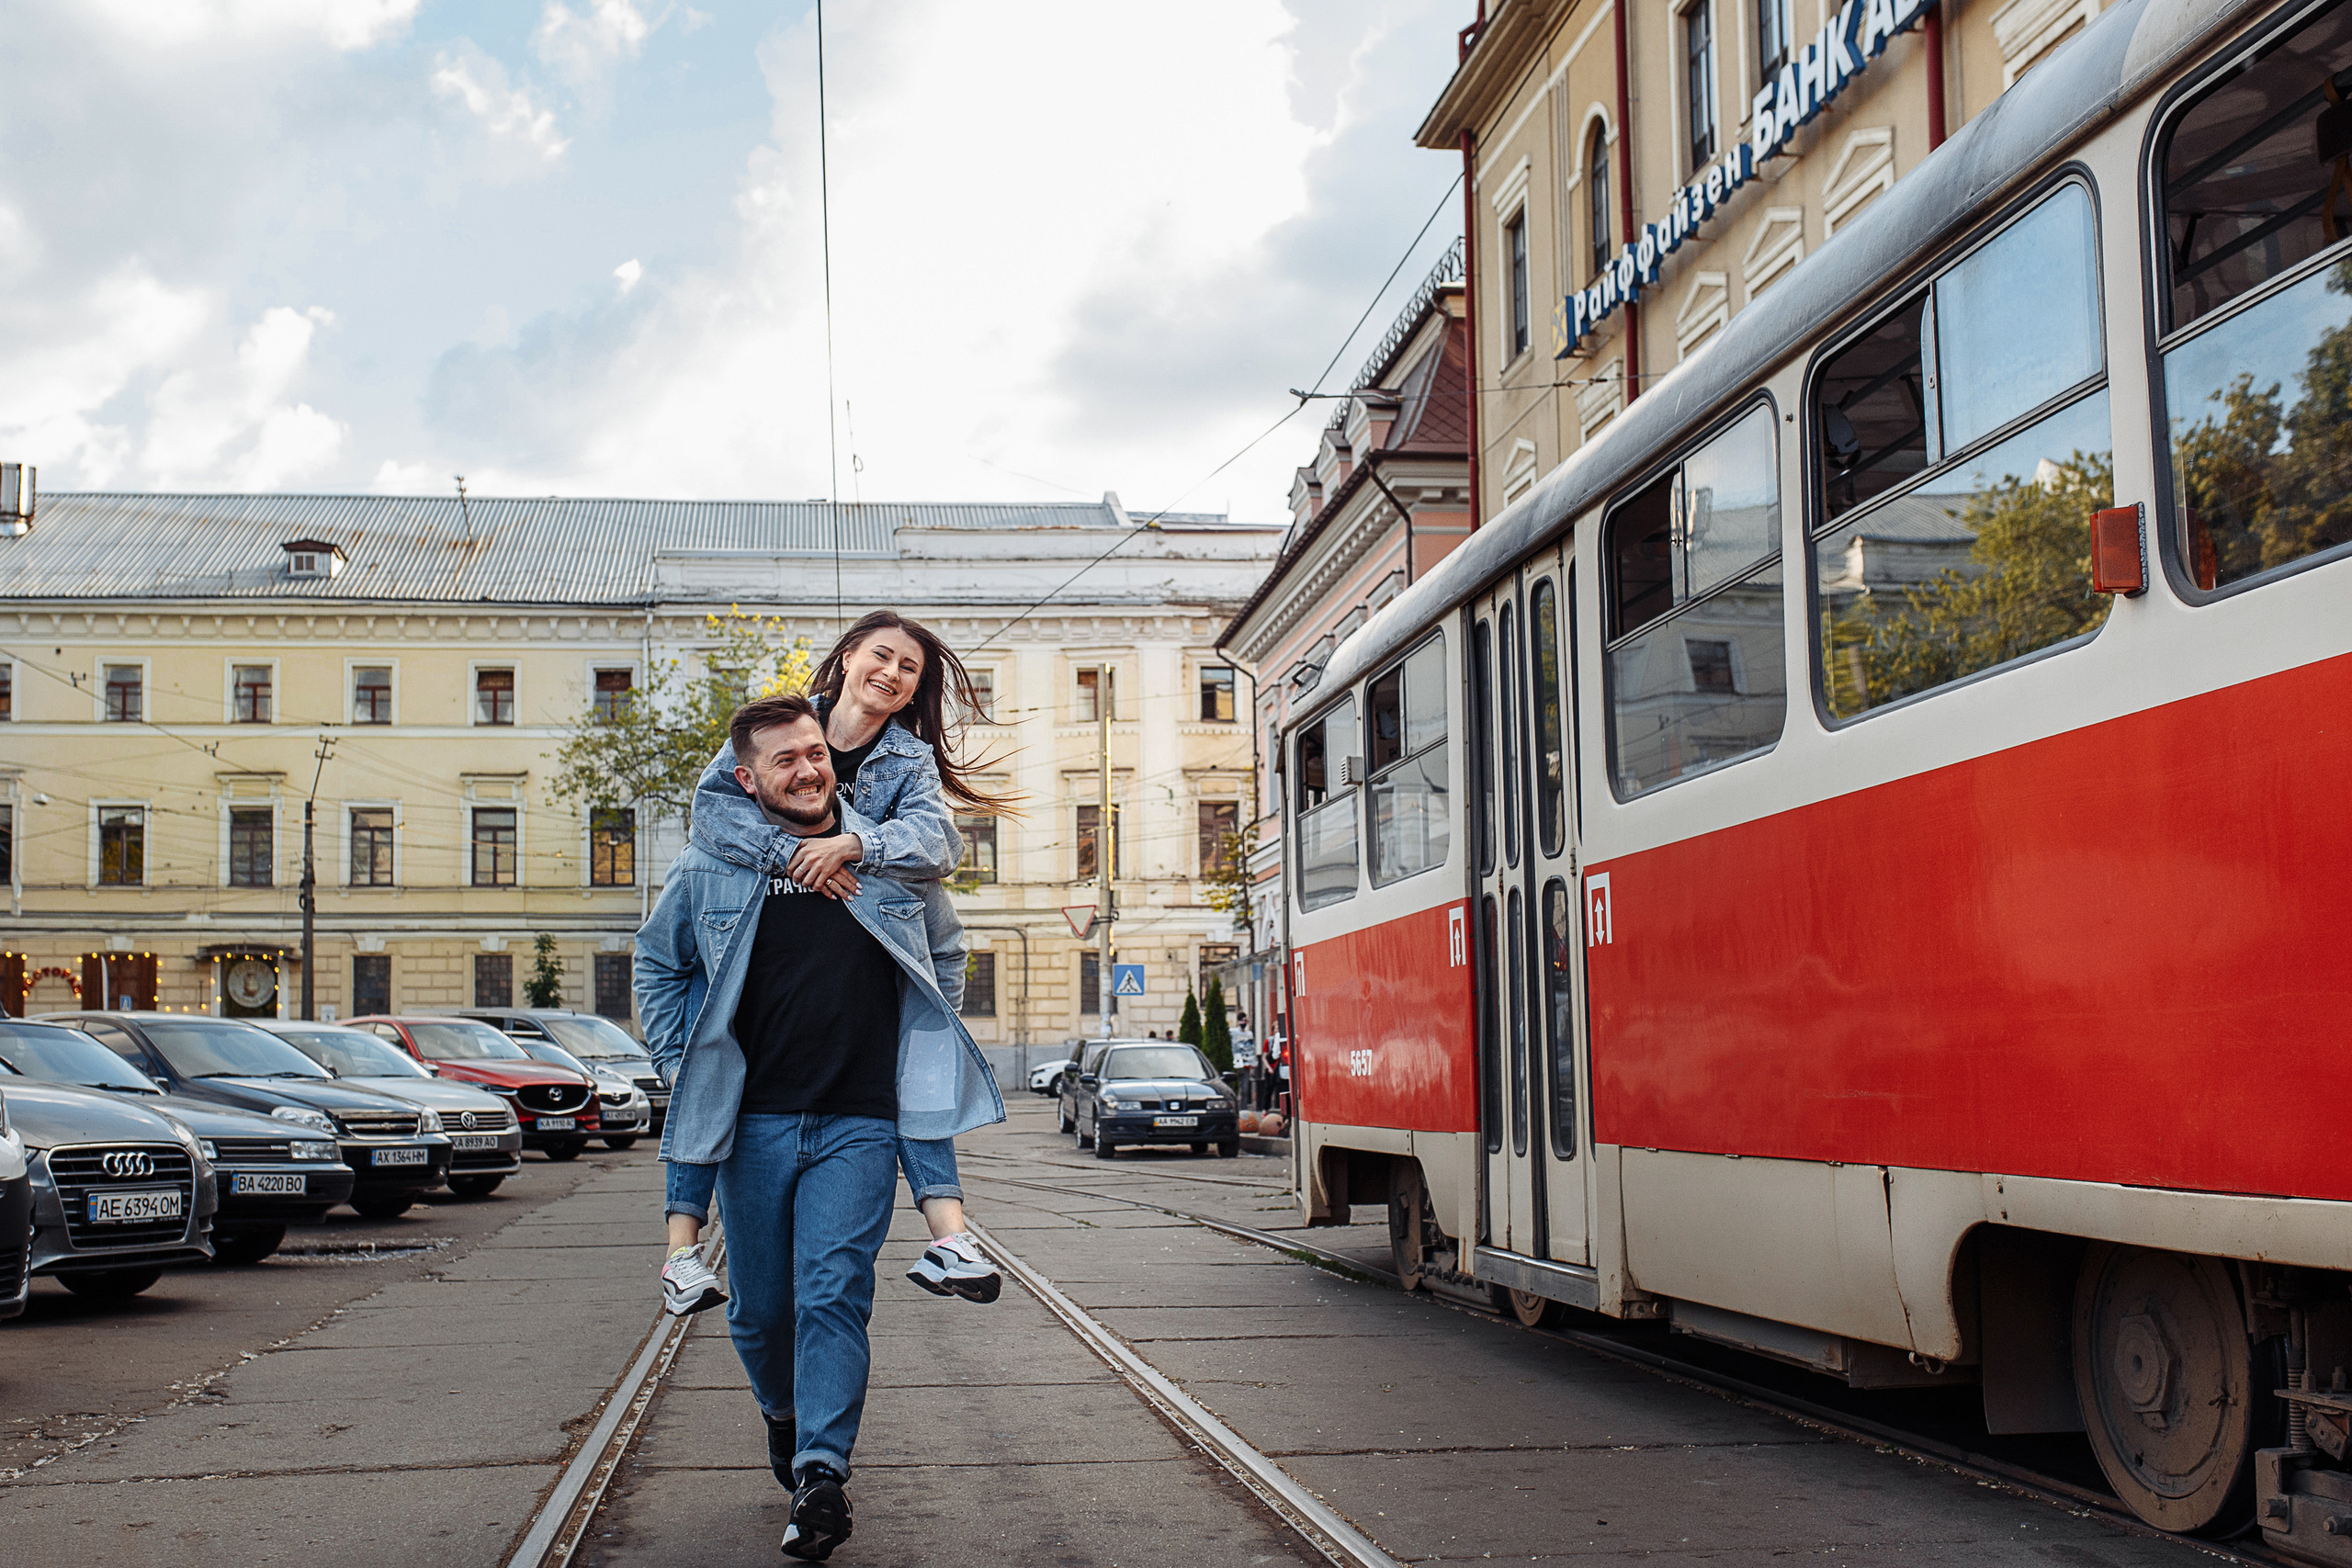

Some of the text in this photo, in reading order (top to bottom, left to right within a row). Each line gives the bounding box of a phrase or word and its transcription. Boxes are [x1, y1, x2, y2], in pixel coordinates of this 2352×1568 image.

[1573, 143, 1742, 337] Райффайзен
[1752, 0, 1854, 164] БАНК
[1351, 1048, 1373, 1077] 5657
[377, 1151, 390, 1164] AX
[239, 1176, 301, 1191] BA 4220 BO
[98, 1196, 179, 1218] AE 6394 OM
